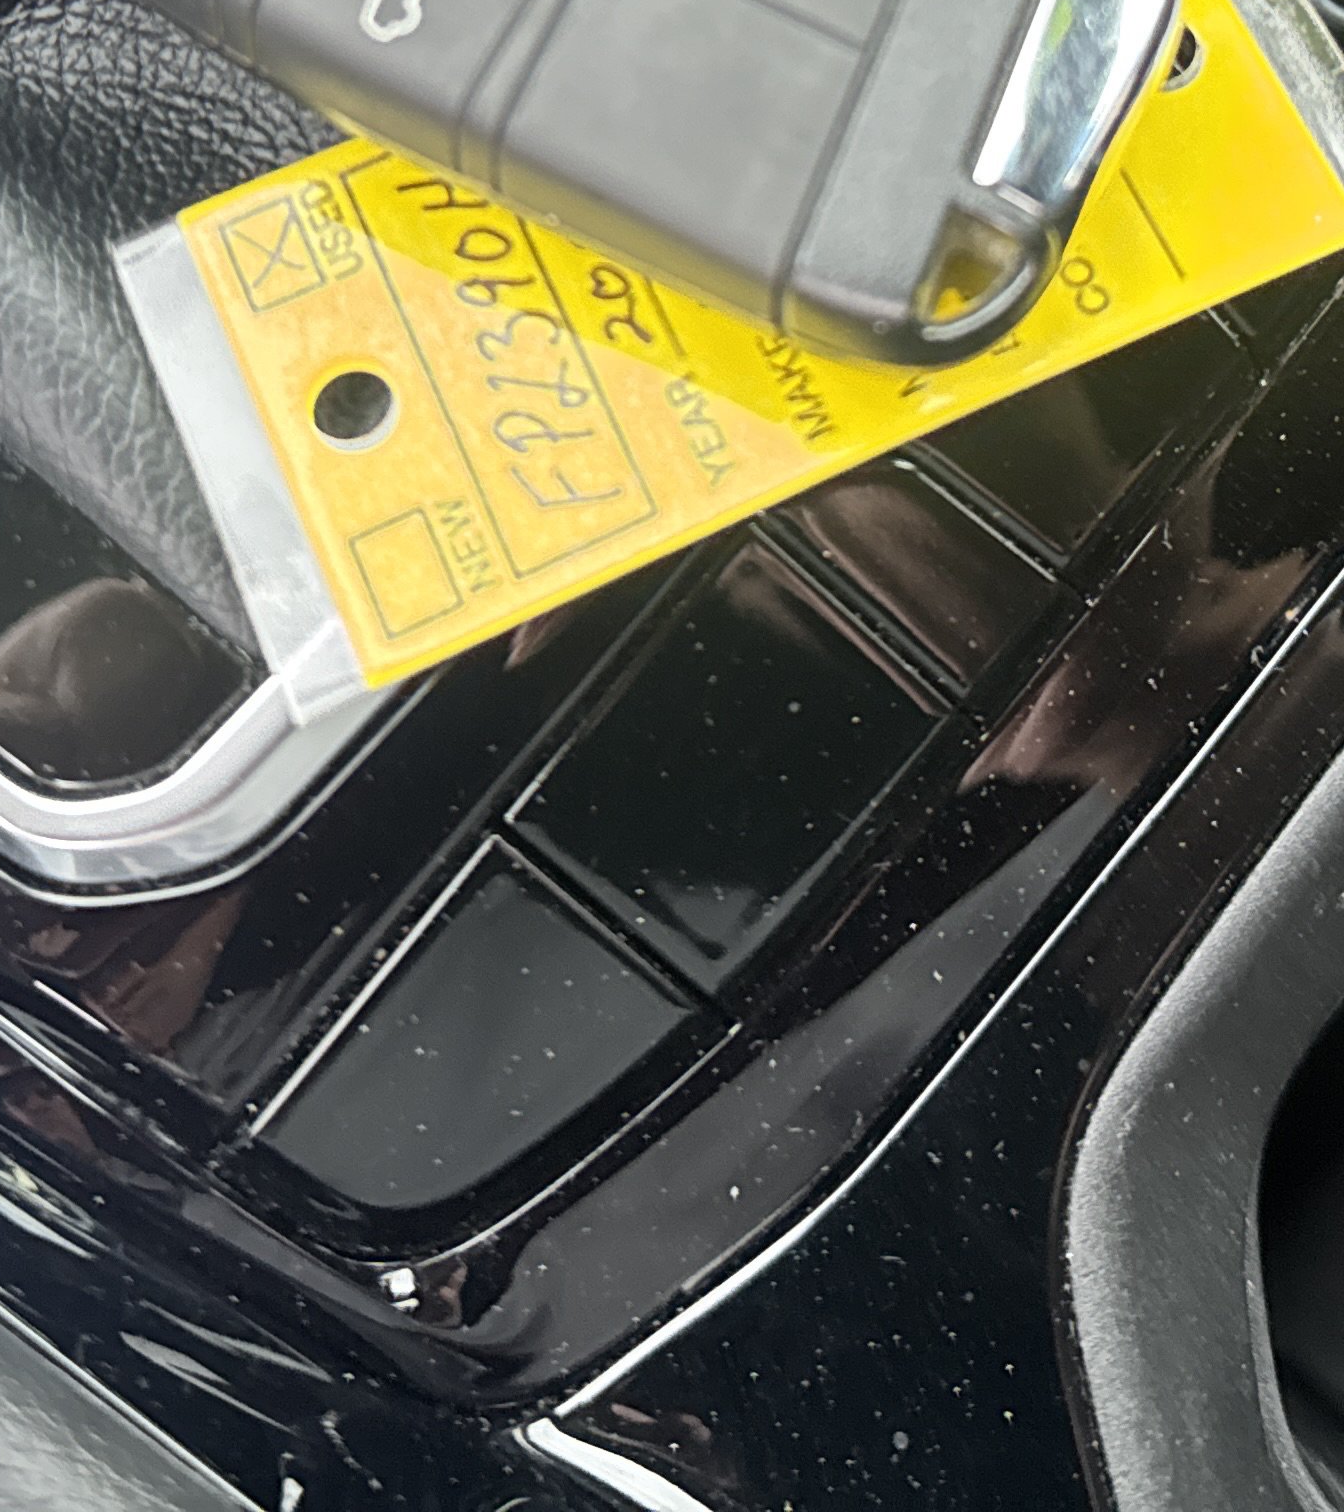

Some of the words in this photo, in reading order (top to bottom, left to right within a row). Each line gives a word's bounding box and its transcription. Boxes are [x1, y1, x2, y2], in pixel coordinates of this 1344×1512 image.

[299, 177, 366, 281] USED
[665, 369, 737, 488] YEAR
[433, 497, 504, 595] NEW
